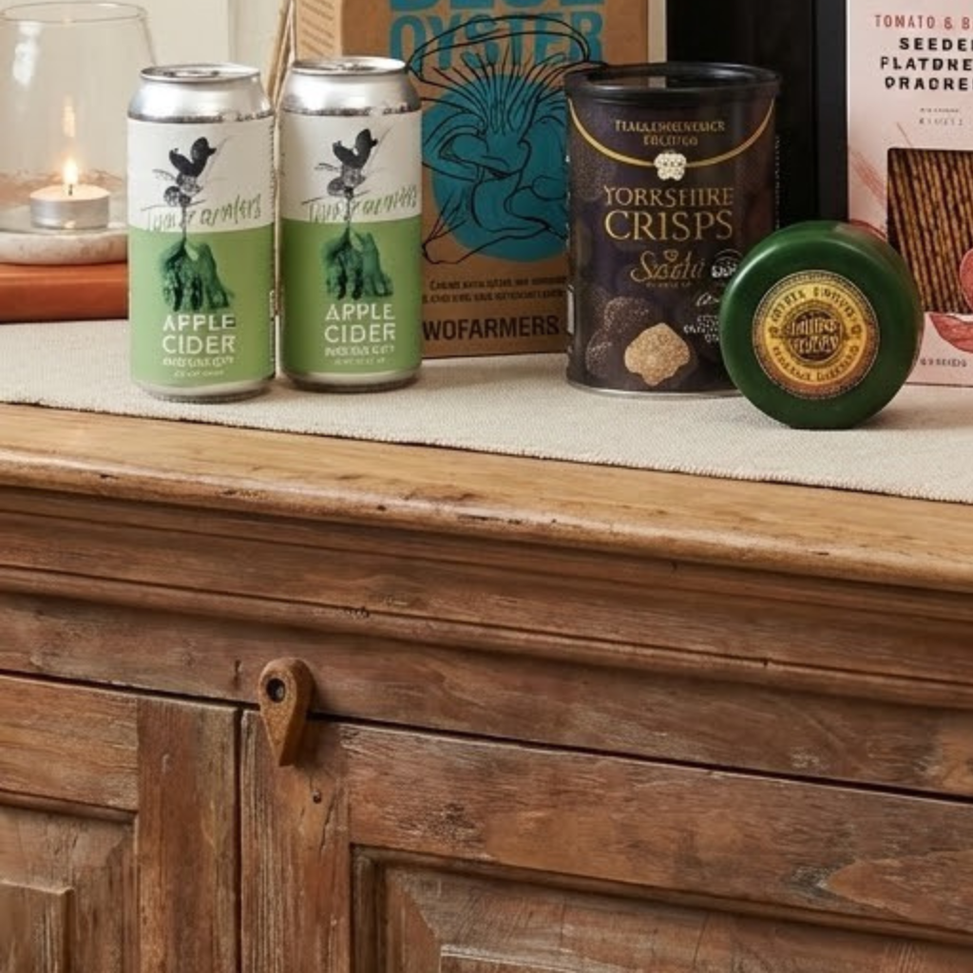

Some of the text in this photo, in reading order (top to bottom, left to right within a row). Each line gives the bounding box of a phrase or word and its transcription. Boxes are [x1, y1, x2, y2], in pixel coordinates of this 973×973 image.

[875, 15, 936, 29] TOMATO
[604, 209, 733, 242] CRISPS
[324, 303, 396, 321] APPLE
[324, 323, 396, 343] CIDER
[162, 335, 236, 354] CIDER
